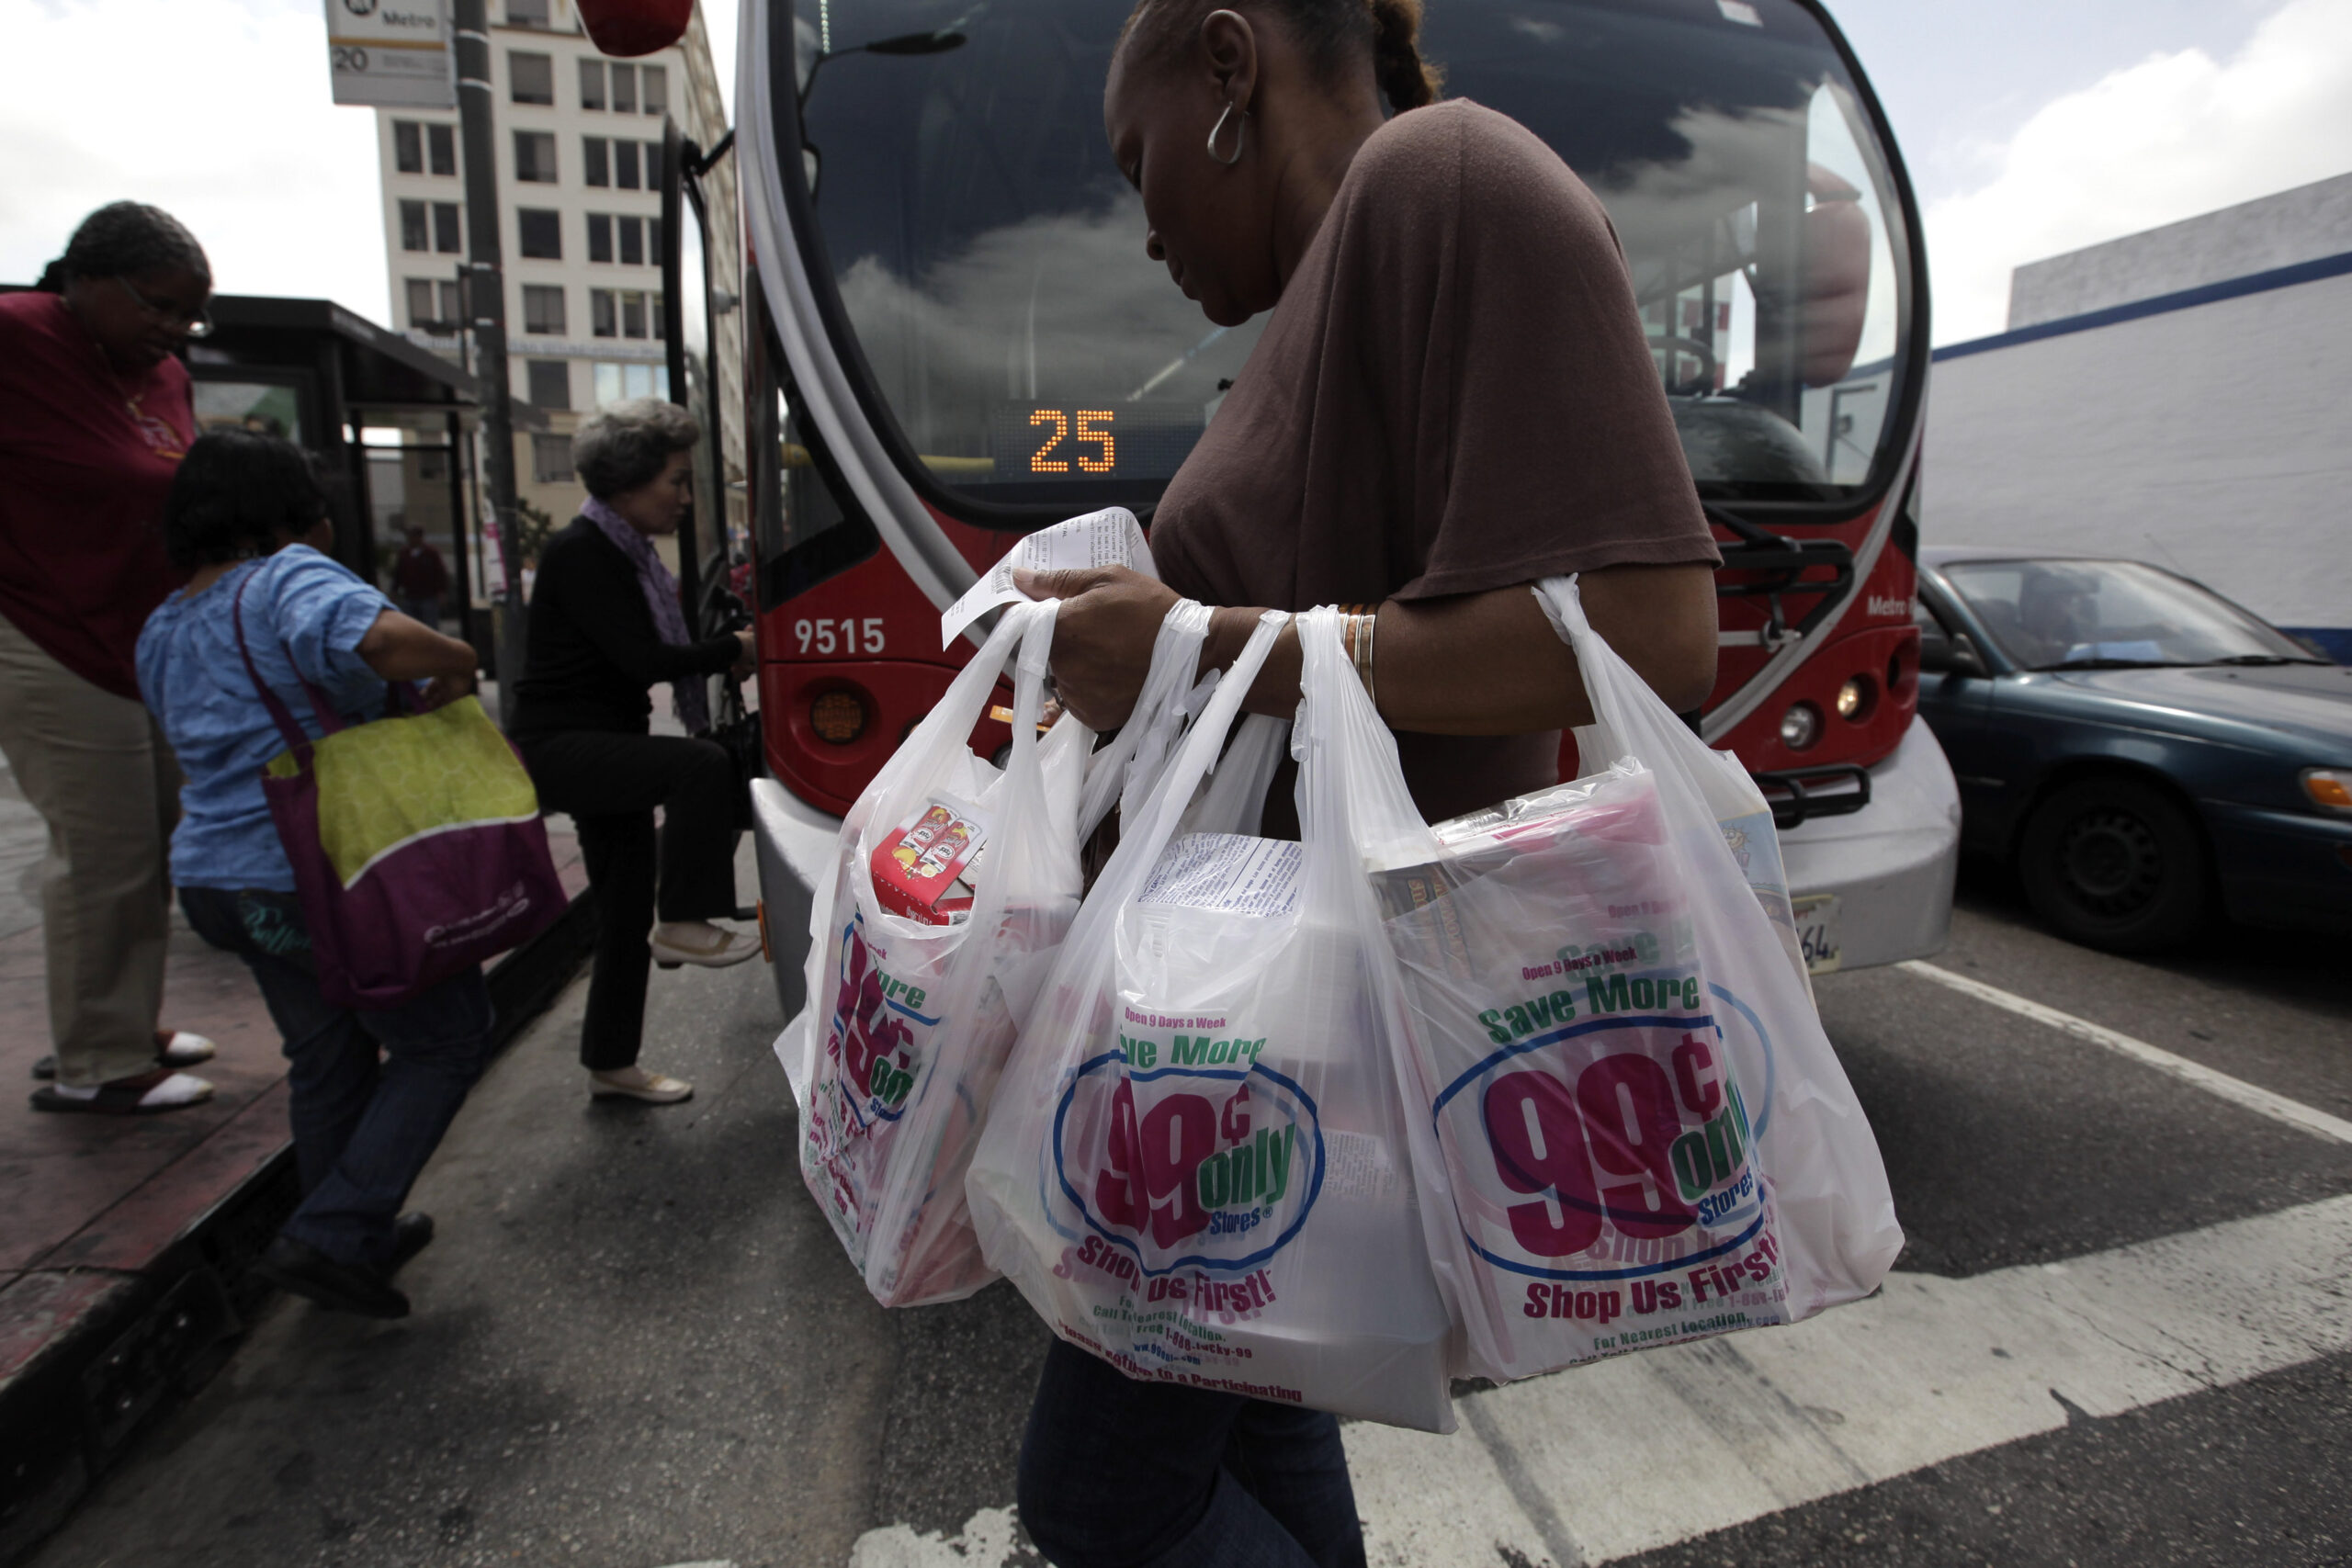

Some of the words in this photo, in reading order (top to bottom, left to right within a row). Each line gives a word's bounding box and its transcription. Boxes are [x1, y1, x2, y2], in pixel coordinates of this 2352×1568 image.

[382, 11, 435, 28] Metro
[334, 47, 368, 72] 20
[1030, 410, 1115, 472] 25
[1867, 595, 1907, 616] Metro
[794, 617, 886, 654] 9515
[1797, 924, 1829, 963] 64
[1521, 964, 1554, 981] Open
[1554, 960, 1563, 975] 9
[1564, 954, 1592, 973] Days
[1593, 953, 1601, 965] a
[1602, 946, 1638, 964] Week
[877, 968, 927, 1010] ore
[1125, 1006, 1148, 1026] Open
[1149, 1014, 1157, 1027] 9
[1159, 1015, 1185, 1030] Days
[1187, 1019, 1194, 1029] a
[1196, 1017, 1227, 1030] Week
[1478, 989, 1577, 1044] Save
[1586, 973, 1701, 1015] More
[1198, 1122, 1295, 1209] only
[1210, 1207, 1261, 1235] Stores
[1193, 1269, 1277, 1314] First!
[1523, 1282, 1622, 1324] Shop
[1630, 1280, 1682, 1314] Us
[1092, 1304, 1118, 1320] Call
[1136, 1323, 1164, 1336] Free
[1179, 1314, 1227, 1343] Location.
[1594, 1336, 1616, 1351] For
[1619, 1323, 1679, 1345] Nearest
[1680, 1311, 1750, 1335] Location.
[1190, 1372, 1303, 1404] Participating
